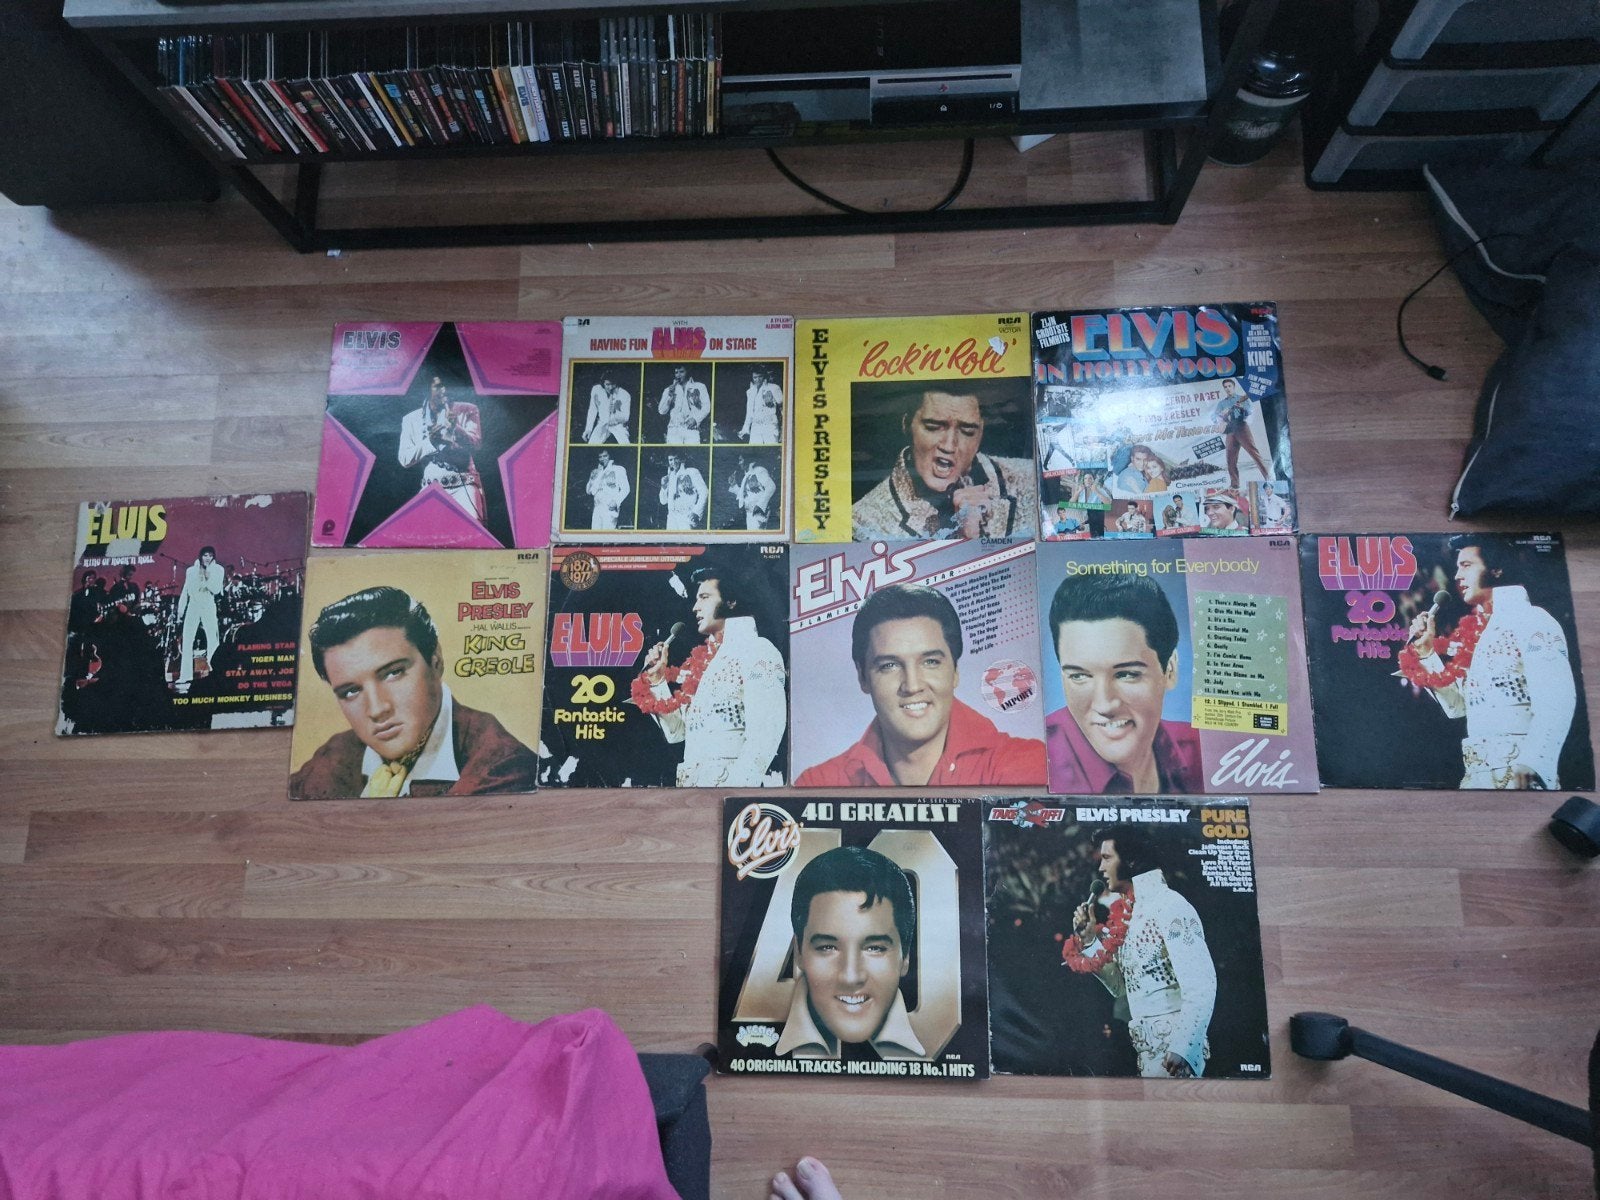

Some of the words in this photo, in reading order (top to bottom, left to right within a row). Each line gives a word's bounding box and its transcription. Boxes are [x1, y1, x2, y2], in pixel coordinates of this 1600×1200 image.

[552, 72, 562, 91] ELVIS
[573, 69, 582, 88] ELVIS
[561, 121, 570, 138] ELVIS
[579, 118, 588, 135] ELVIS
[999, 326, 1022, 334] VICTOR
[1036, 322, 1069, 339] GROOTSTE
[1071, 309, 1239, 361] ELVIS
[341, 330, 402, 350] ELVIS
[590, 338, 627, 351] HAVING
[629, 338, 648, 351] FUN
[651, 326, 707, 358] ELVIS
[709, 337, 723, 351] ON
[726, 337, 757, 351] STAGE
[1039, 333, 1071, 349] FILMHITS
[1247, 350, 1274, 366] KING
[811, 328, 830, 410] ELVIS
[1037, 362, 1068, 384] IN
[1072, 356, 1237, 383] HOLLYWOOD
[1194, 390, 1220, 402] PAGET
[813, 413, 831, 530] PRESLEY
[87, 504, 168, 545] ELVIS
[981, 537, 1013, 545] CAMDEN
[760, 546, 784, 554] RCA
[570, 560, 591, 571] 1877
[1066, 559, 1148, 577] Something
[1151, 558, 1172, 573] for
[1175, 557, 1260, 576] Everybody
[1317, 536, 1419, 590] ELVIS
[569, 571, 591, 583] 1977
[793, 541, 917, 617] Elvis
[955, 580, 968, 590] Much
[471, 581, 521, 600] ELVIS
[799, 603, 859, 628] FLAMING
[926, 570, 957, 586] STAR
[457, 602, 534, 622] PRESLEY
[1233, 600, 1249, 608] Always
[1344, 590, 1396, 624] 20
[473, 623, 489, 631] HAL
[490, 621, 518, 631] WALLIS
[965, 621, 985, 631] Flaming
[986, 617, 997, 625] Star
[550, 612, 645, 667] ELVIS
[972, 637, 985, 645] Tiger
[1331, 623, 1409, 643] Fantastic
[238, 643, 272, 651] FLAMING
[464, 633, 526, 655] KING
[1357, 641, 1392, 659] Hits
[277, 654, 295, 662] MAN
[454, 653, 535, 678] CREOLE
[225, 669, 246, 677] STAY
[279, 667, 295, 675] JOE
[570, 674, 615, 704] 20
[173, 697, 190, 705] TOO
[191, 696, 215, 704] MUCH
[217, 695, 251, 703] MONKEY
[253, 693, 293, 702] BUSINESS
[1000, 687, 1034, 711] IMPORT
[554, 706, 625, 724] Fantastic
[575, 723, 605, 740] Hits
[1211, 738, 1300, 789] Elvis
[801, 802, 834, 821] 40
[840, 802, 961, 823] GREATEST
[1075, 806, 1119, 822] ELVIS
[1120, 808, 1191, 823] PRESLEY
[1201, 808, 1247, 823] PURE
[1202, 824, 1250, 839] GOLD
[1201, 843, 1232, 851] Jailhouse
[1208, 849, 1218, 857] Up
[1228, 859, 1251, 867] Tender
[1233, 864, 1252, 872] Cruel
[1228, 875, 1253, 883] Ghetto
[1242, 881, 1254, 889] Up
[730, 1059, 746, 1072] 40
[746, 1059, 799, 1073] ORIGINAL
[799, 1060, 842, 1074] TRACKS
[847, 1061, 908, 1075] INCLUDING
[909, 1062, 921, 1075] 18
[948, 1063, 976, 1077] HITS
[1240, 1063, 1262, 1072] RCA
